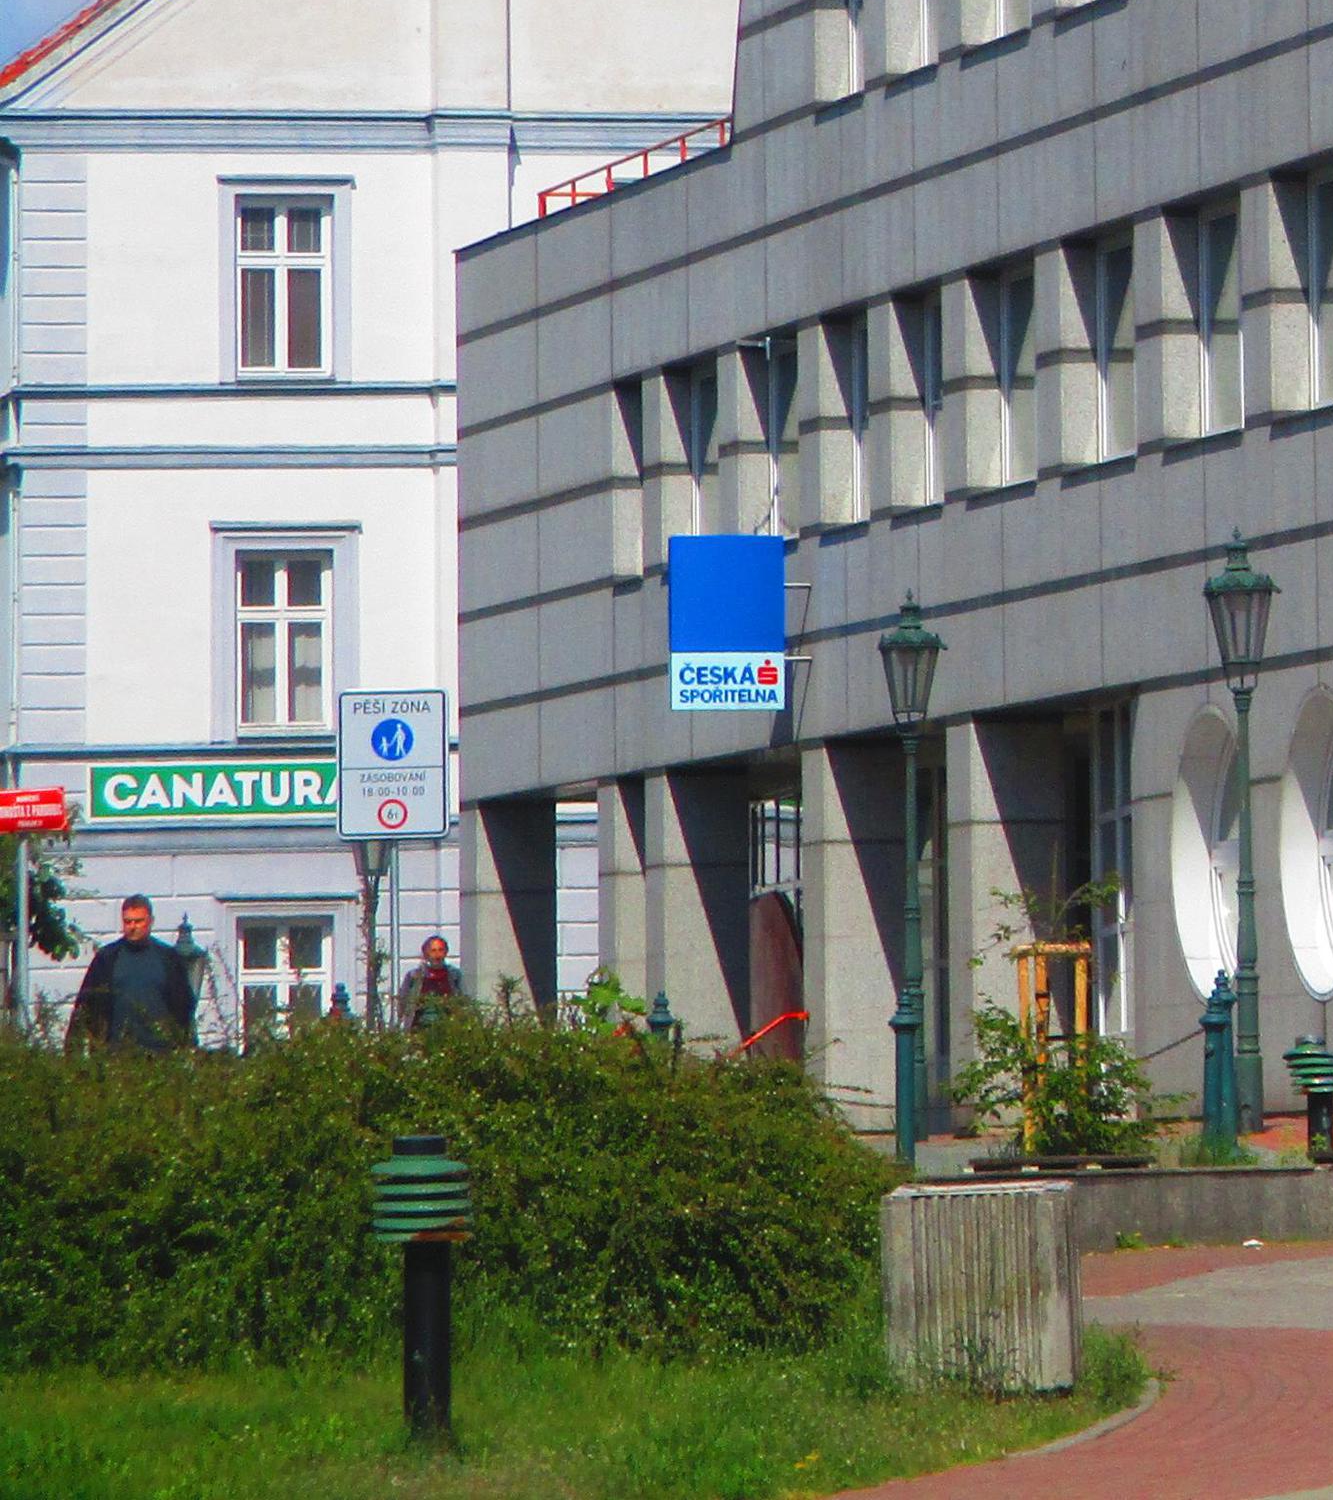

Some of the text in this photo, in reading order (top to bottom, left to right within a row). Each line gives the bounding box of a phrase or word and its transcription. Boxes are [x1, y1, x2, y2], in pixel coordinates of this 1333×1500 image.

[679, 662, 756, 685] ČESKÁ
[679, 686, 778, 704] SPOŘITELNA
[353, 698, 431, 715] PĚŠÍ ZÓNA
